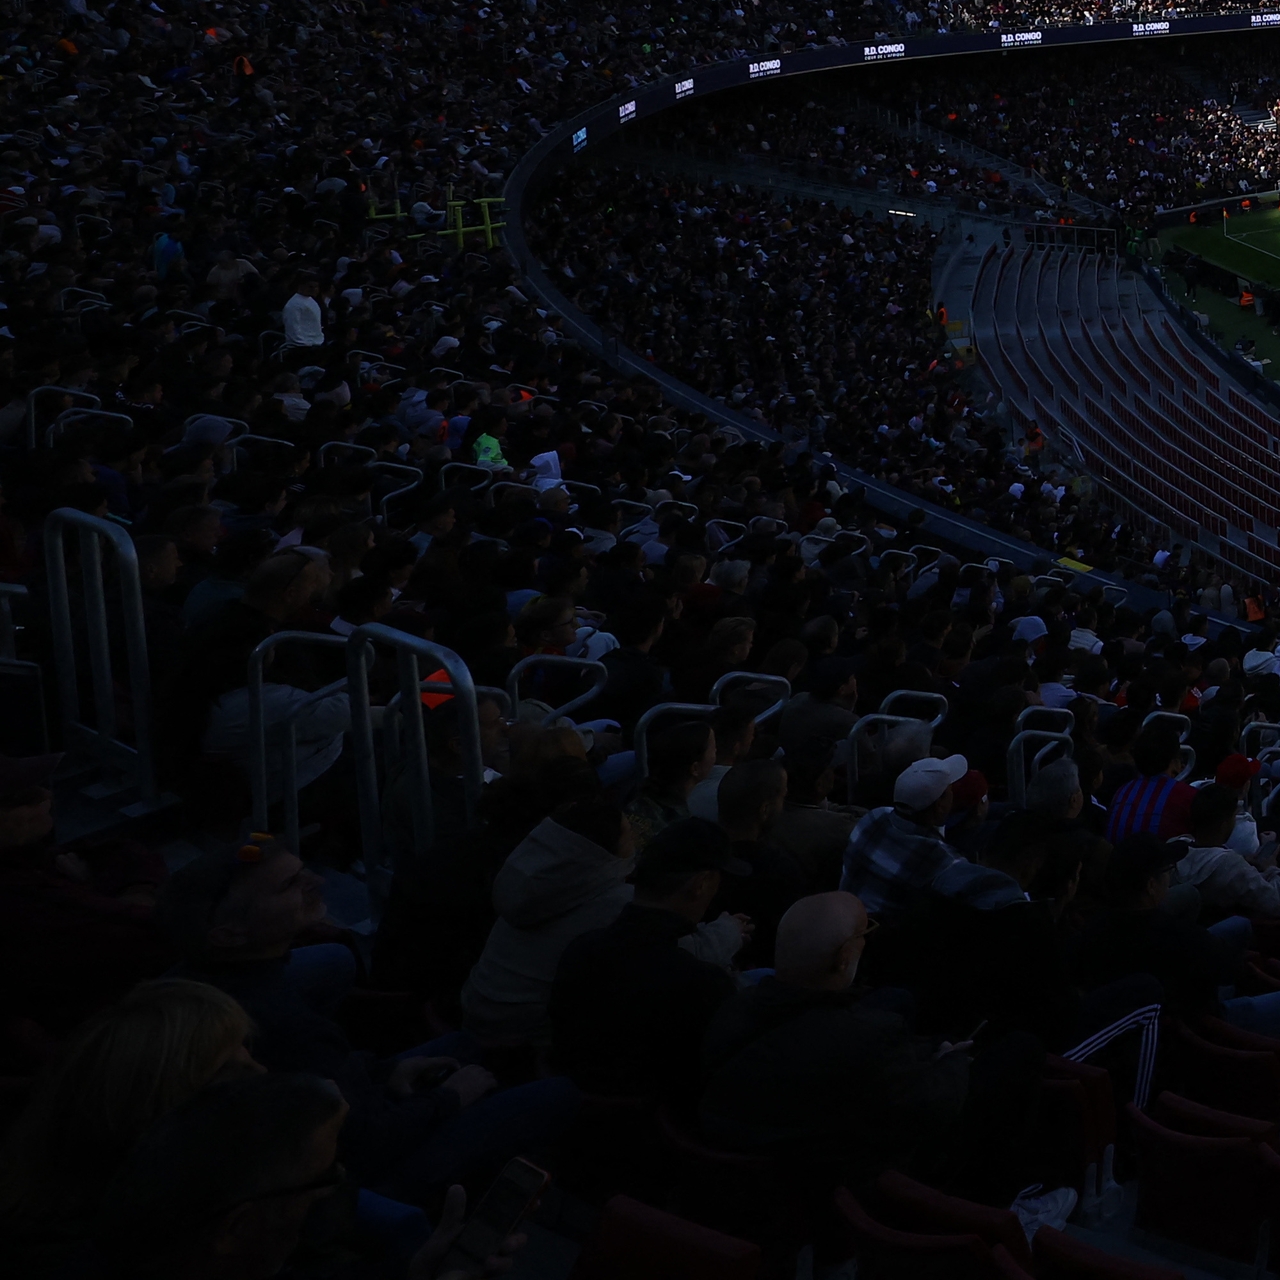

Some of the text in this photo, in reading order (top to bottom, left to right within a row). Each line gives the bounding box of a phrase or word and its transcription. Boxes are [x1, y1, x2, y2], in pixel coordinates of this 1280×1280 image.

[1132, 22, 1169, 32] R.D. CONGO
[1001, 31, 1042, 42] R.D. CONGO
[864, 44, 904, 55] R.D. CONGO
[760, 59, 780, 71] CONGO
